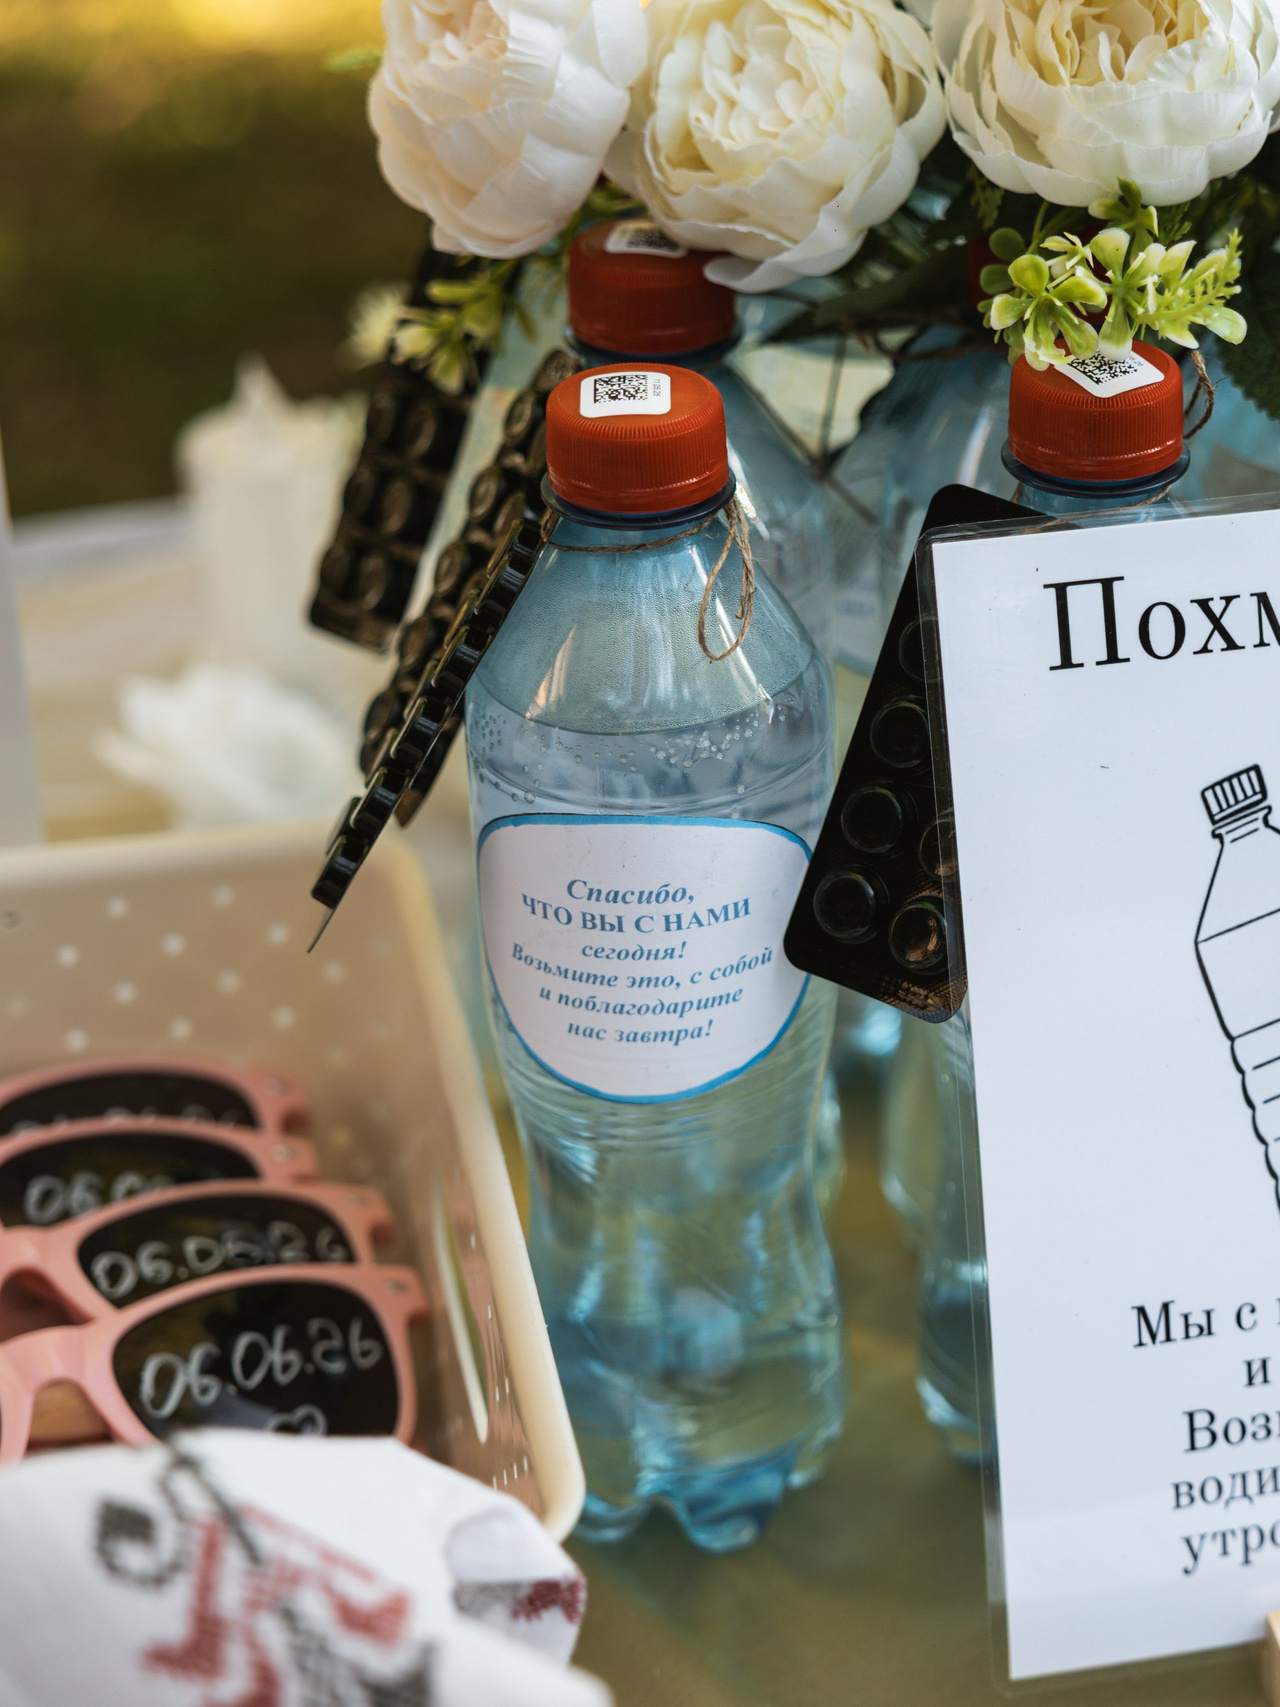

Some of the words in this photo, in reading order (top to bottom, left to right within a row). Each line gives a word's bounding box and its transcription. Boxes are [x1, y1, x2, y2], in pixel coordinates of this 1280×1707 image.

[566, 878, 695, 906] Спасибо,
[520, 892, 573, 926] ЧТО
[580, 909, 627, 934] ВЫ
[634, 914, 655, 934] С
[662, 897, 751, 933] НАМИ
[511, 942, 620, 989] Возьмите
[625, 974, 681, 990] это,
[690, 972, 703, 984] с
[709, 945, 774, 981] собой
[581, 941, 687, 961] сегодня!
[539, 985, 553, 1001] и
[556, 986, 744, 1020] поблагодарите
[567, 1021, 608, 1041] нас
[614, 1018, 714, 1047] завтра!
[1131, 1299, 1216, 1348] Мы
[1235, 1301, 1258, 1332] с
[1243, 1356, 1271, 1388] и
